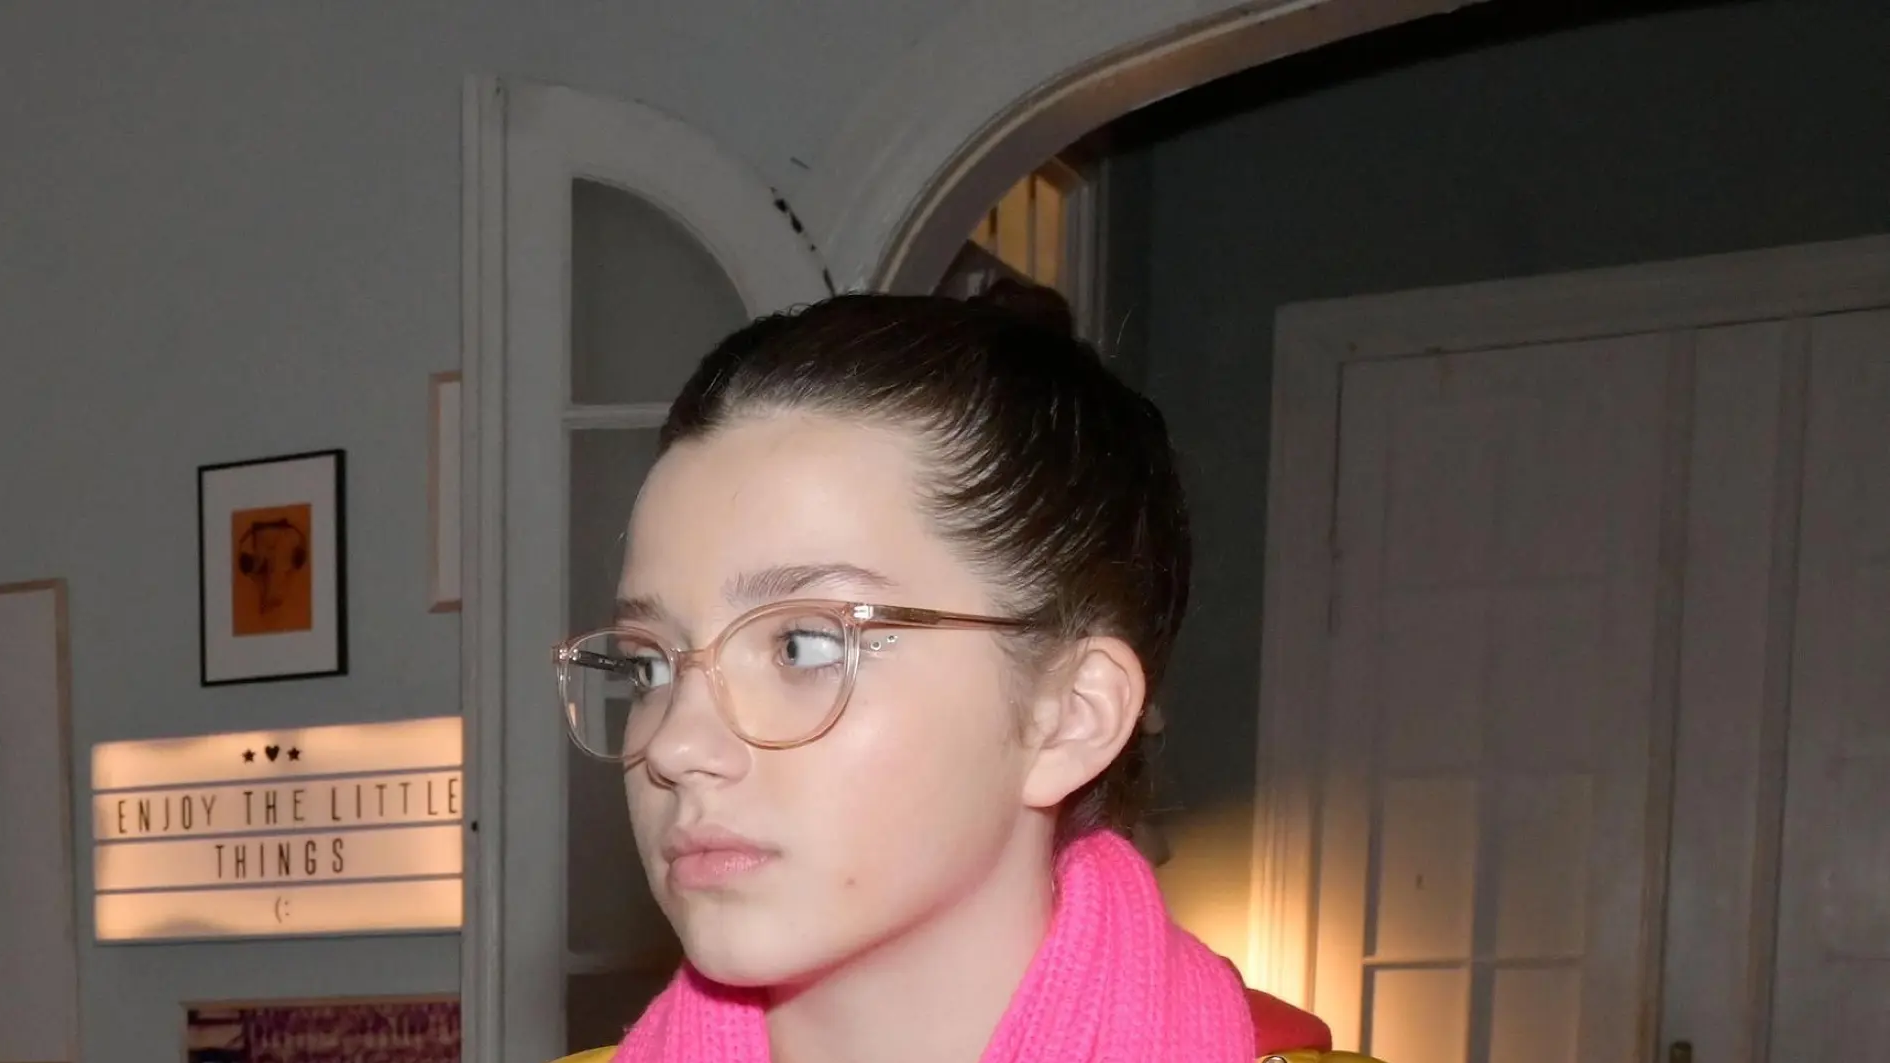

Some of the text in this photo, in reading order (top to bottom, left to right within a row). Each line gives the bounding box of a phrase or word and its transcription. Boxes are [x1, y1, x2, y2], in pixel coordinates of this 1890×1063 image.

[117, 777, 459, 833] ENJOY THE LITTLE
[214, 837, 344, 879] THINGS
